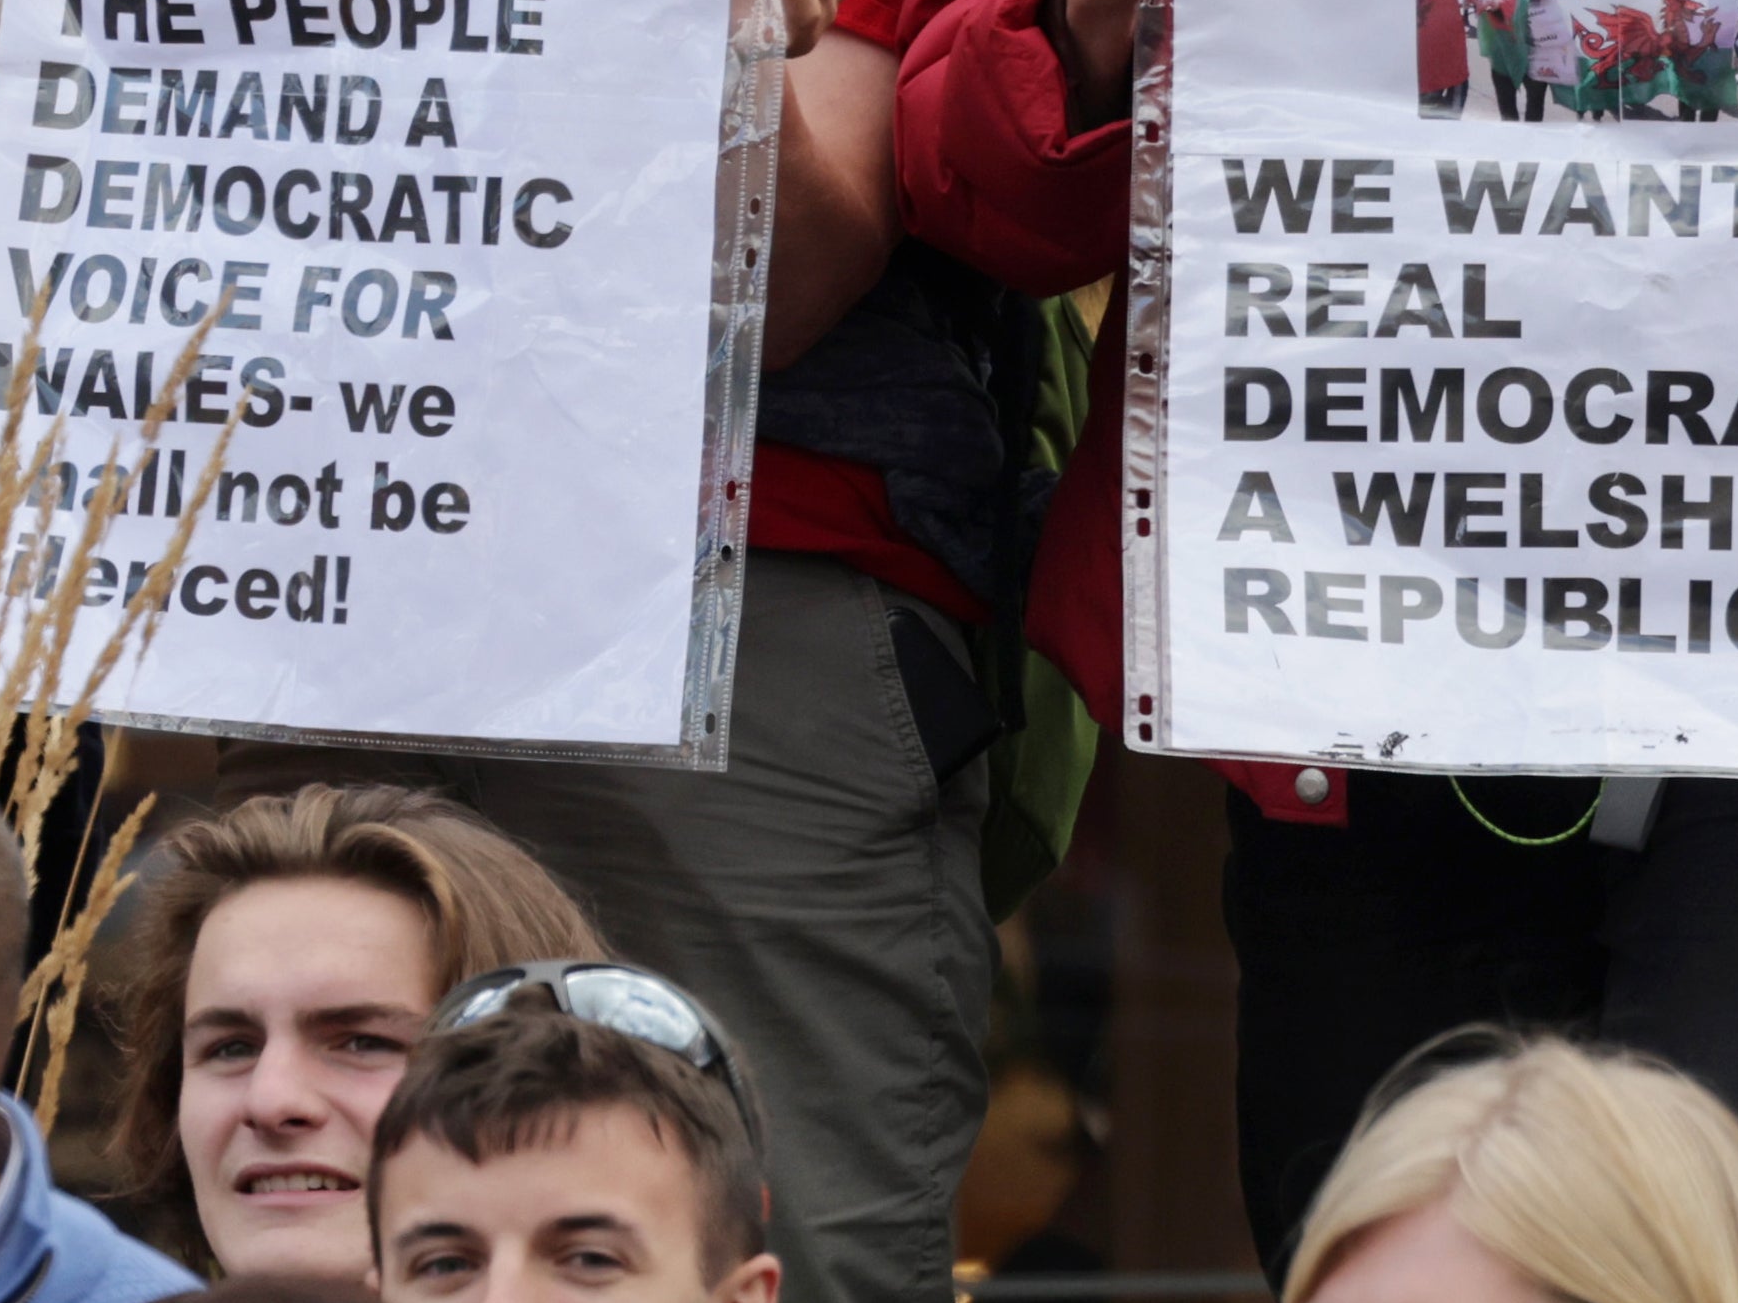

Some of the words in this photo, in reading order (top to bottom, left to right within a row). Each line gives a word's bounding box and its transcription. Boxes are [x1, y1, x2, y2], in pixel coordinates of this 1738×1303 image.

[31, 60, 383, 148] DEMAND
[406, 78, 459, 149] A
[18, 154, 574, 251] DEMOCRATIC
[1221, 159, 1394, 235] WE
[9, 249, 269, 333] VOICE
[293, 265, 458, 342] FOR
[1224, 262, 1523, 339] REAL
[338, 381, 456, 438] we
[216, 458, 344, 530] not
[369, 460, 471, 535] be
[1217, 470, 1295, 543] A
[1333, 471, 1734, 552] WELSH
